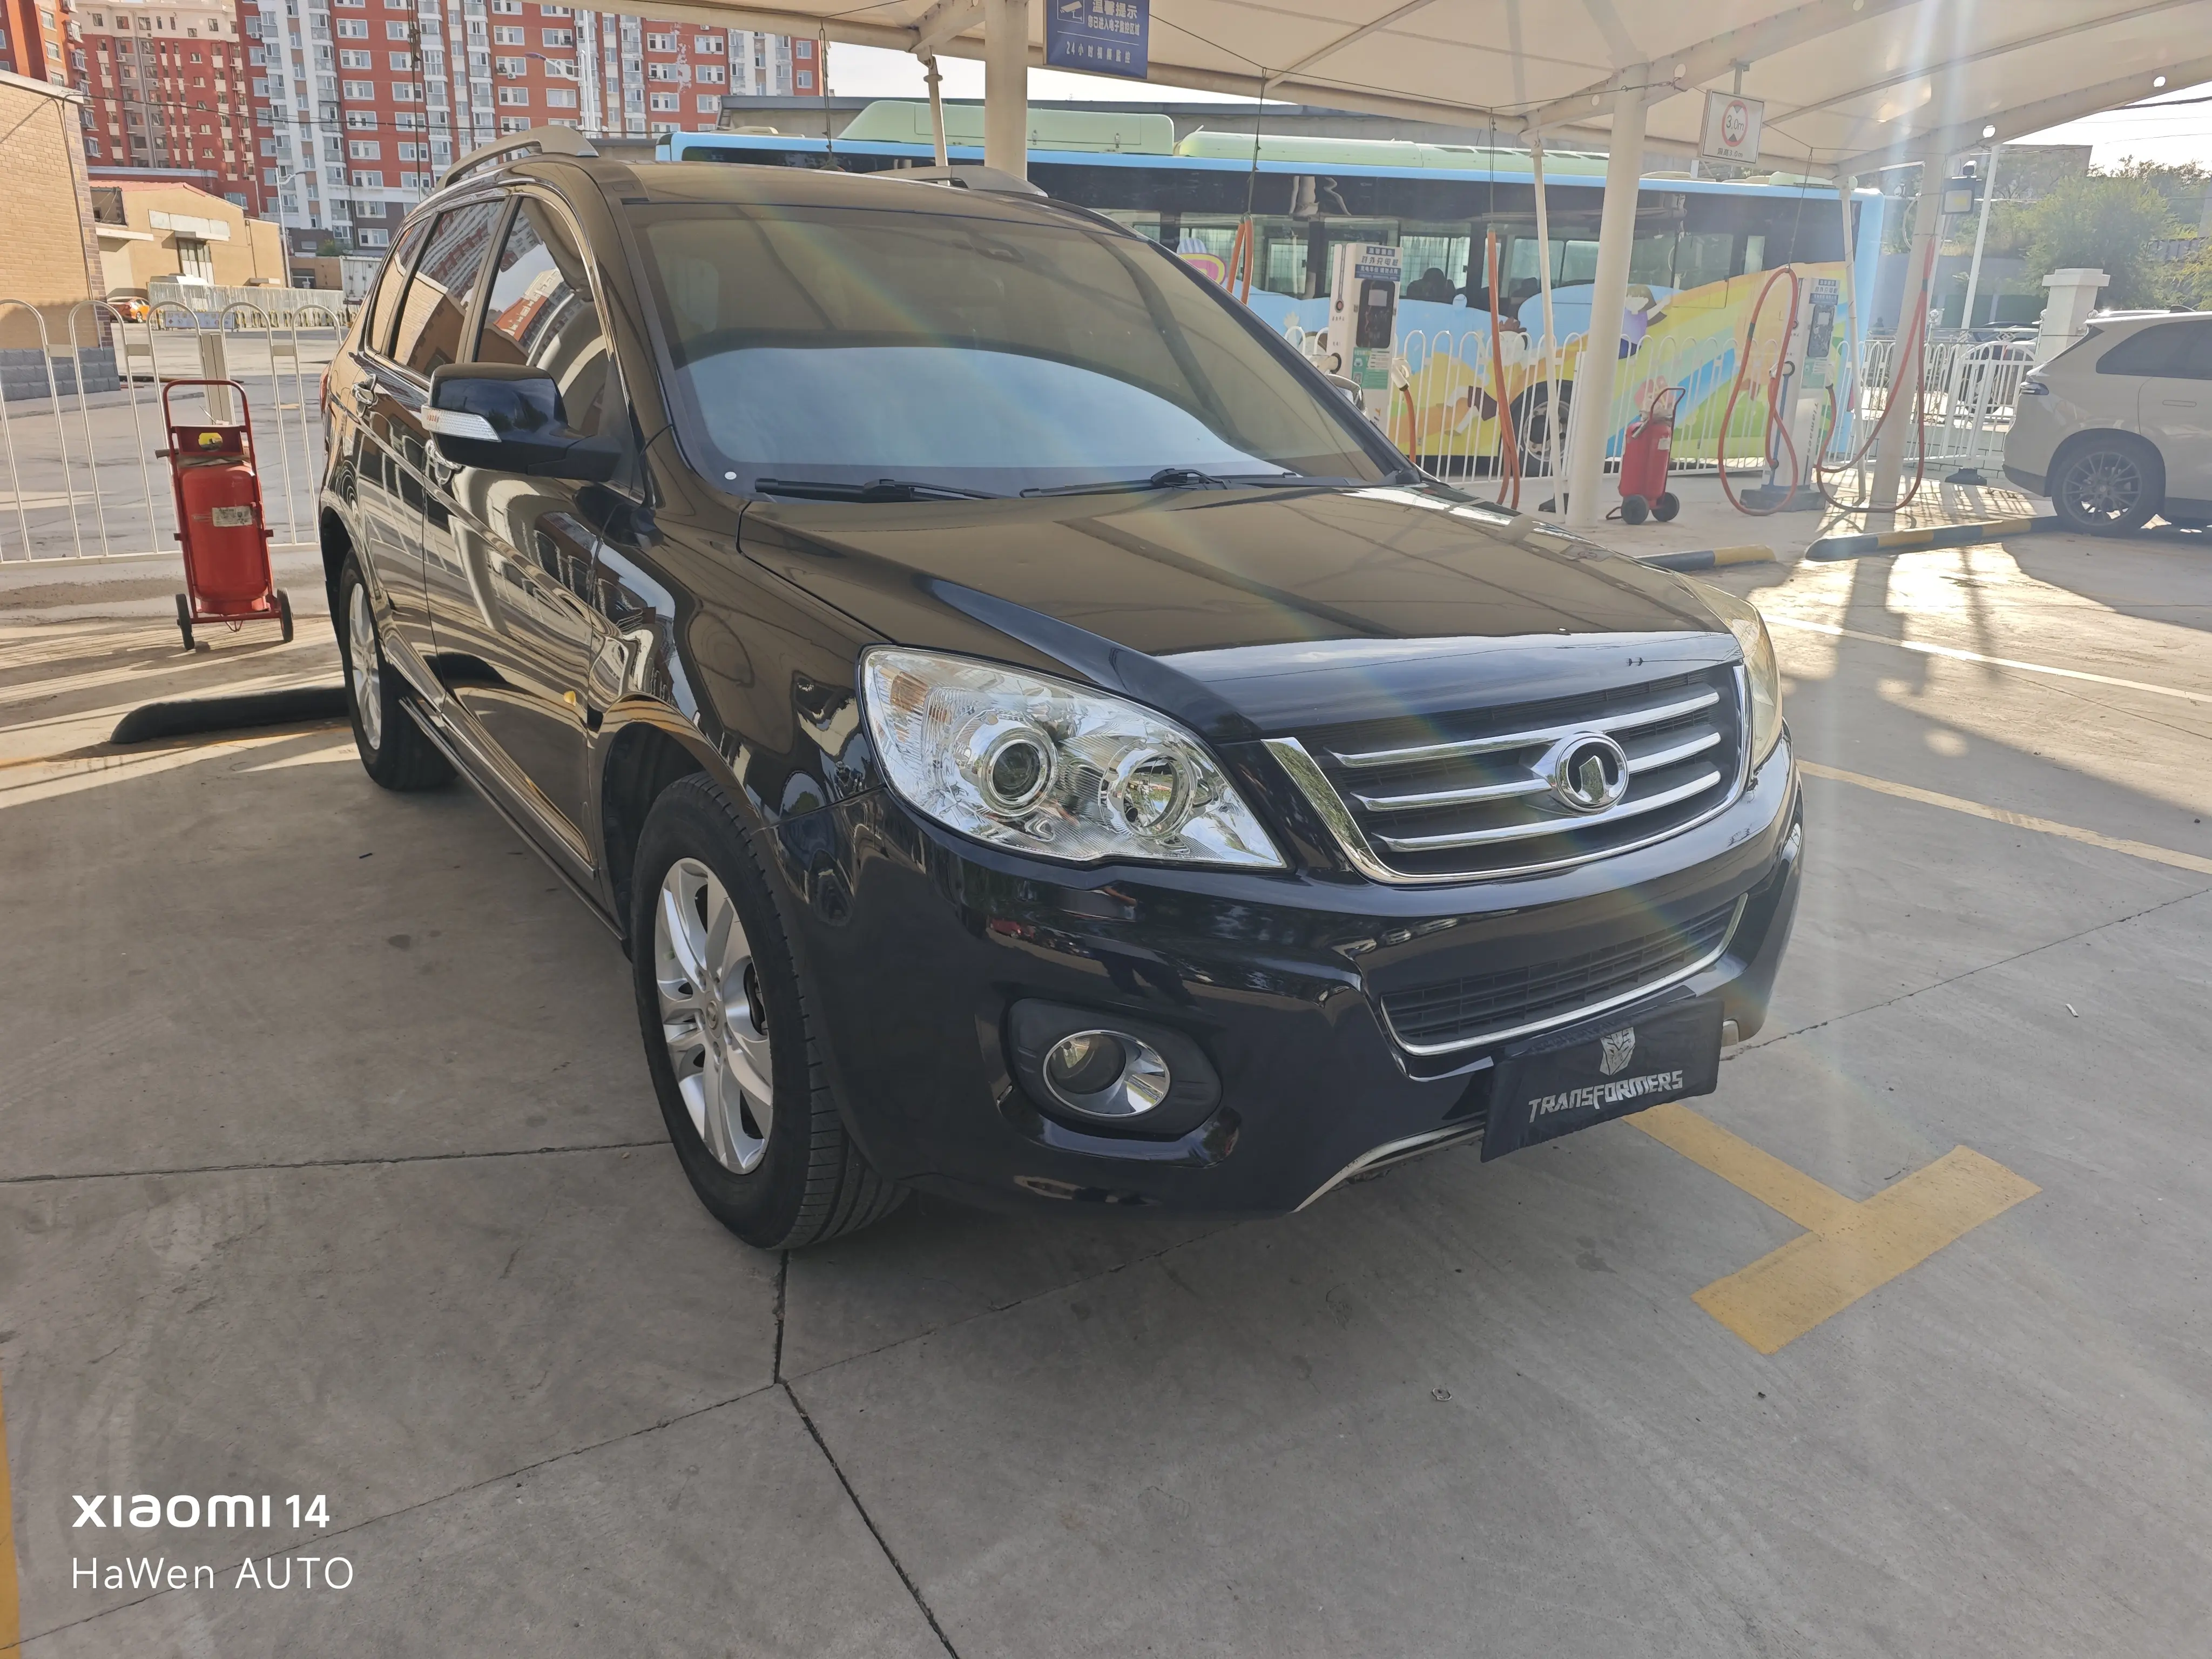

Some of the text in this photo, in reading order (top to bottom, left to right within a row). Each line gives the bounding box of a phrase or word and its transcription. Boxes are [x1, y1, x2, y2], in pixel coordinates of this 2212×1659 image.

[1092, 0, 1137, 19] 温馨提示
[1088, 15, 1140, 36] 您已进入电子监控区域
[1066, 42, 1130, 63] 24小时视频监控
[1727, 115, 1744, 131] 3.0m
[1717, 148, 1743, 158] 限高3.0m
[1528, 1070, 1683, 1123] TRANSFORMERS
